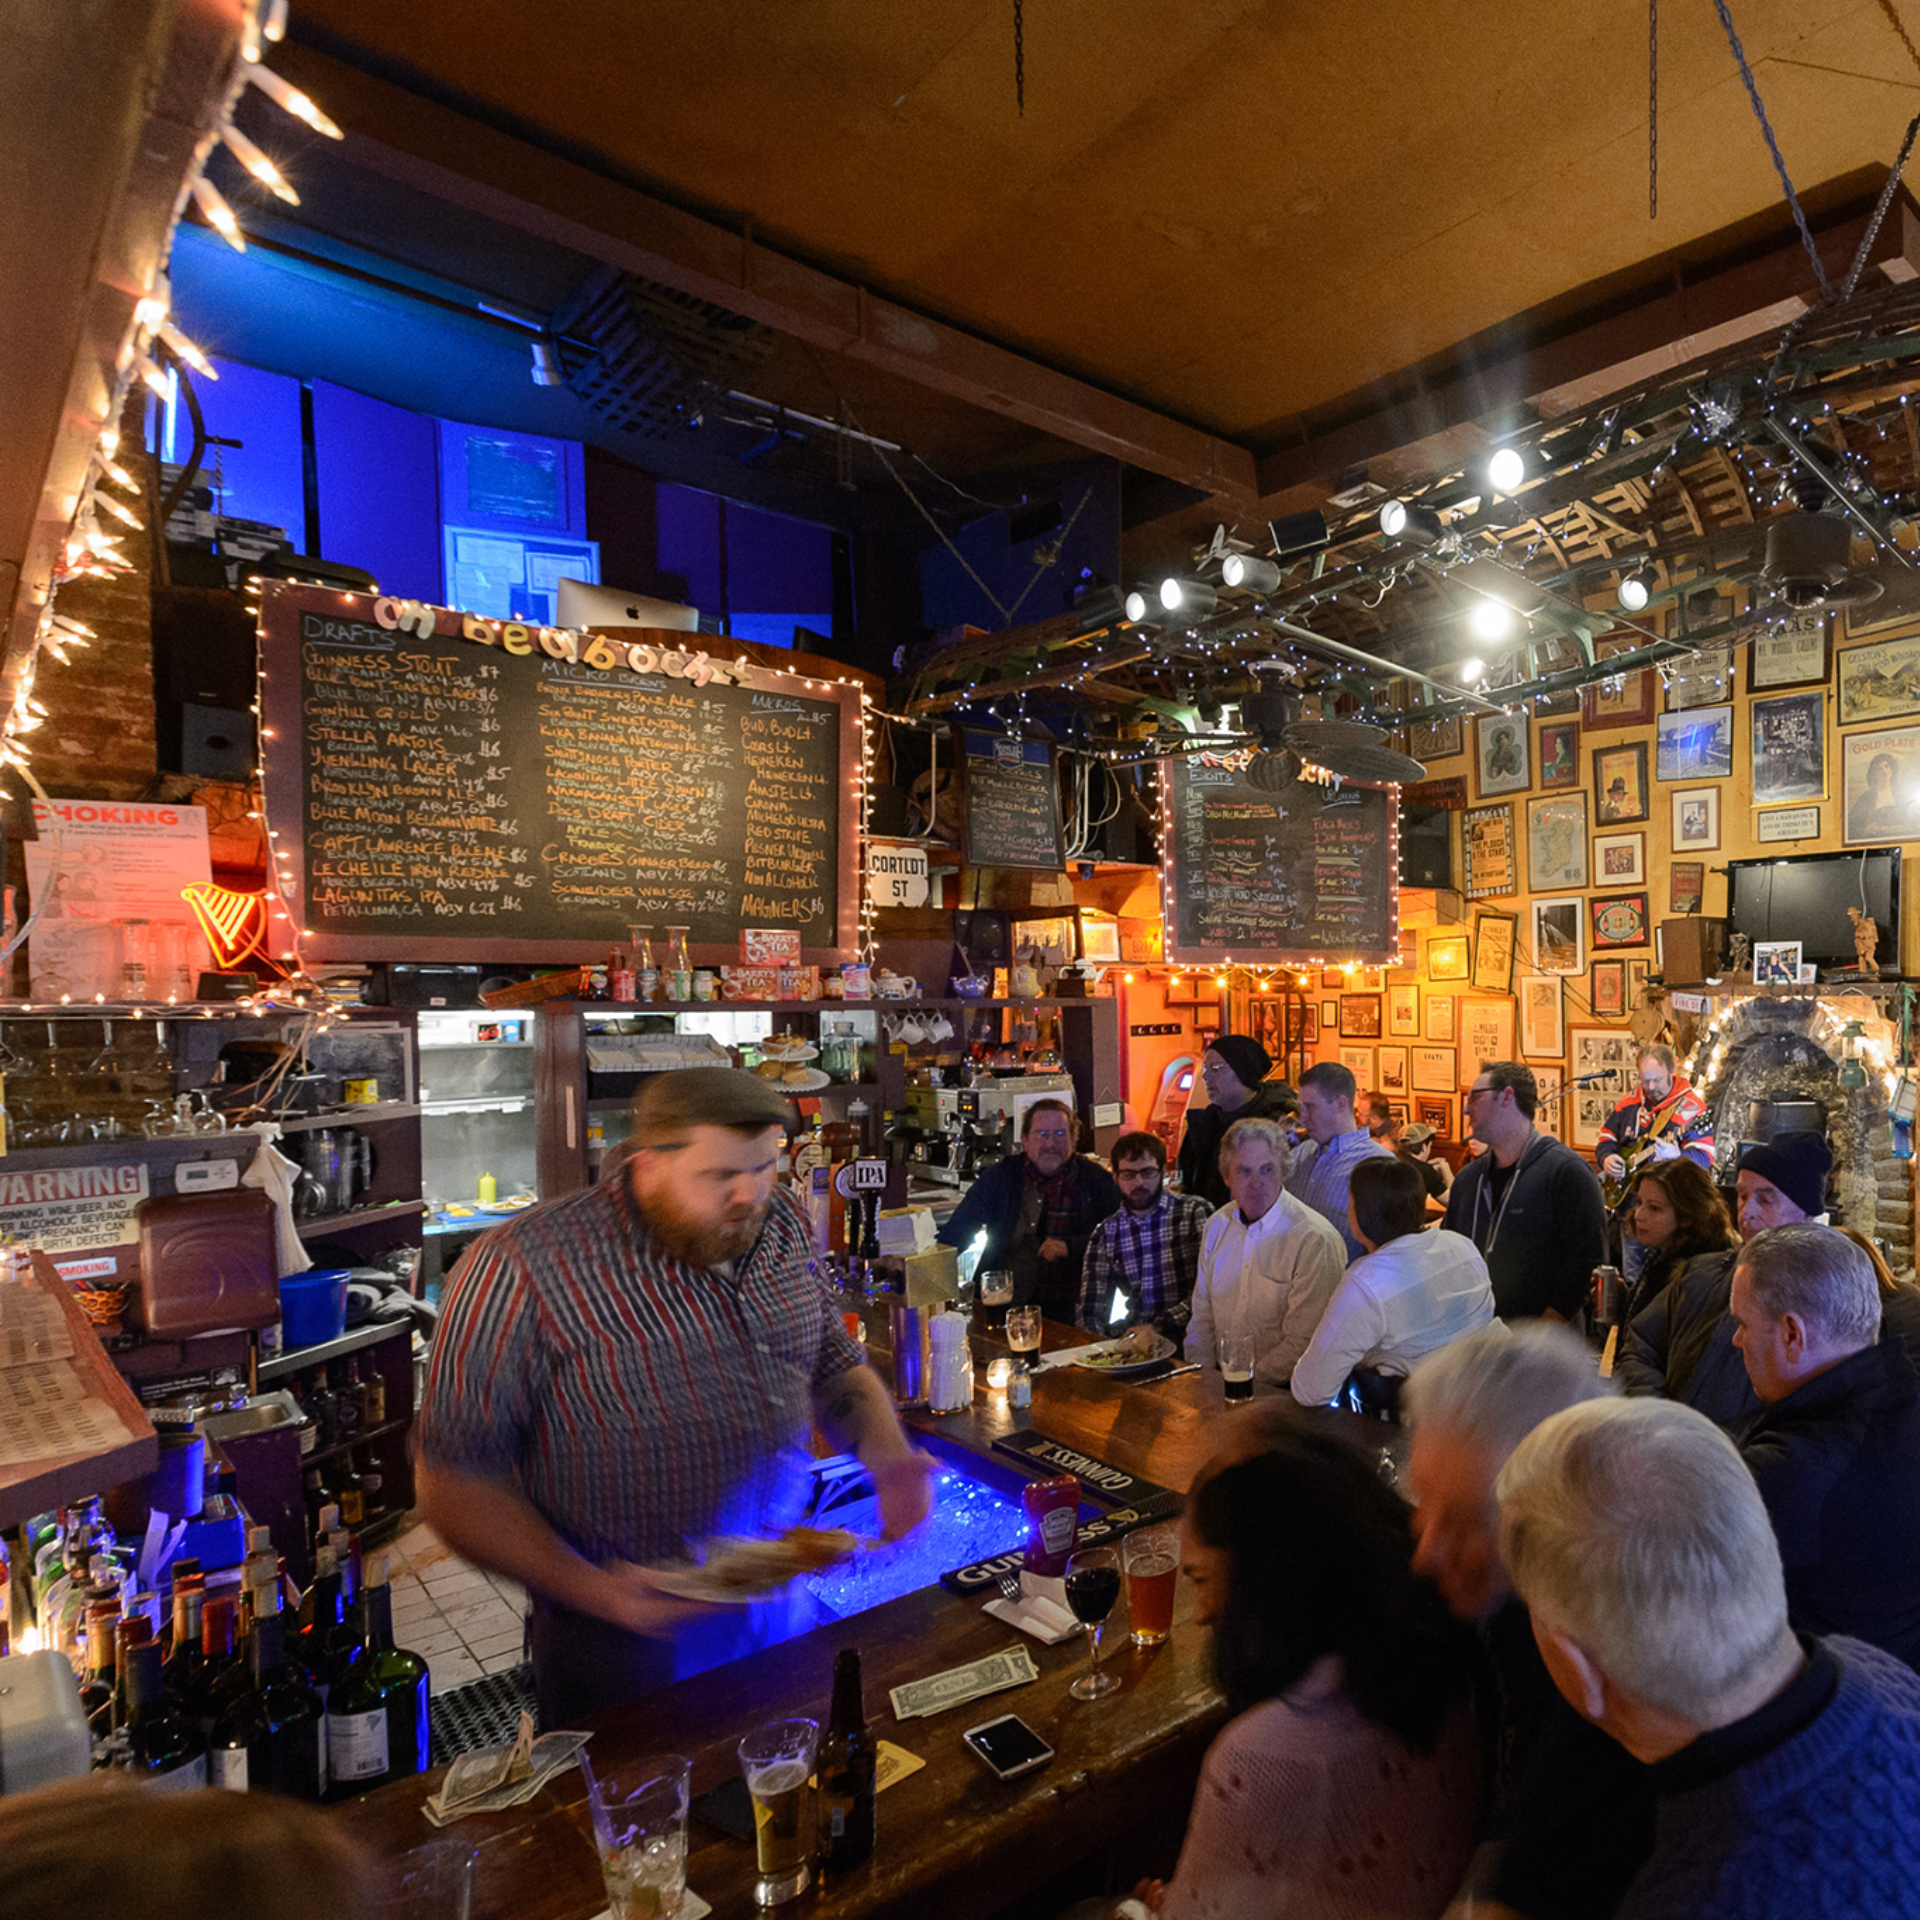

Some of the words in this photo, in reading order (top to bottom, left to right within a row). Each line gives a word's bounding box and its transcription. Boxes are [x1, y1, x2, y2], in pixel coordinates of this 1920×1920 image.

[304, 615, 397, 647] DRAFTS
[302, 642, 392, 671] GUINNESS
[393, 650, 460, 676] STOUT
[476, 664, 500, 680] $7
[669, 693, 698, 709] ALE
[375, 706, 440, 722] GOLD
[379, 721, 401, 732] NY
[769, 718, 796, 738] BUD
[307, 722, 378, 744] STELLA
[386, 731, 447, 754] ARTOIS
[576, 727, 629, 745] BANANA
[741, 732, 775, 755] COORS
[1852, 740, 1882, 755] GOLD
[1884, 737, 1916, 749] PLATE
[403, 755, 458, 776] LAGER
[624, 754, 675, 775] PORTER
[545, 765, 613, 787] LAGUNITAS
[1189, 768, 1232, 783] EVENTS
[310, 773, 389, 799] BROOKLYN
[392, 783, 443, 798] BROWN
[447, 787, 478, 802] ALE
[748, 778, 799, 801] AMSTEL
[32, 804, 180, 826] CHOKING
[310, 802, 352, 820] BLUE
[354, 806, 401, 825] MOON
[587, 806, 636, 824] DRAFT
[642, 815, 687, 832] CIDER
[566, 824, 610, 839] APPLE
[746, 822, 772, 838] RED
[773, 828, 813, 845] STRIPE
[365, 837, 446, 856] LAWRENCE
[745, 837, 786, 856] PILSNER
[541, 843, 625, 866] CRABBIES
[626, 853, 677, 870] GINGER
[872, 854, 925, 875] CORTLDT
[312, 859, 335, 876] LE
[337, 860, 406, 876] CHEILE
[449, 863, 484, 879] RED
[553, 864, 627, 881] SCOTLAND
[321, 876, 360, 888] HOUSE
[551, 880, 636, 898] SCHNEIDER
[892, 879, 909, 897] ST
[312, 886, 413, 904] LAGUNITAS
[419, 889, 447, 905] IPA
[556, 893, 621, 909] GERMANY
[741, 893, 814, 924] MAGNERS
[761, 933, 799, 943] BARRY'S
[770, 943, 791, 952] TEA
[736, 968, 776, 979] BARRY'S
[746, 977, 767, 987] TEA
[782, 978, 802, 987] TEA
[857, 1166, 885, 1184] IPA
[105, 1199, 127, 1210] AND
[20, 1215, 77, 1230] ALCOHOLIC
[40, 1224, 100, 1238] PREGNANCY
[105, 1220, 126, 1232] CAN
[43, 1237, 73, 1250] BIRTH
[75, 1232, 121, 1246] DEFECTS
[57, 1261, 110, 1278] SMOKING
[1047, 1447, 1134, 1491] GUINNESS
[956, 1519, 1112, 1584] GUISS
